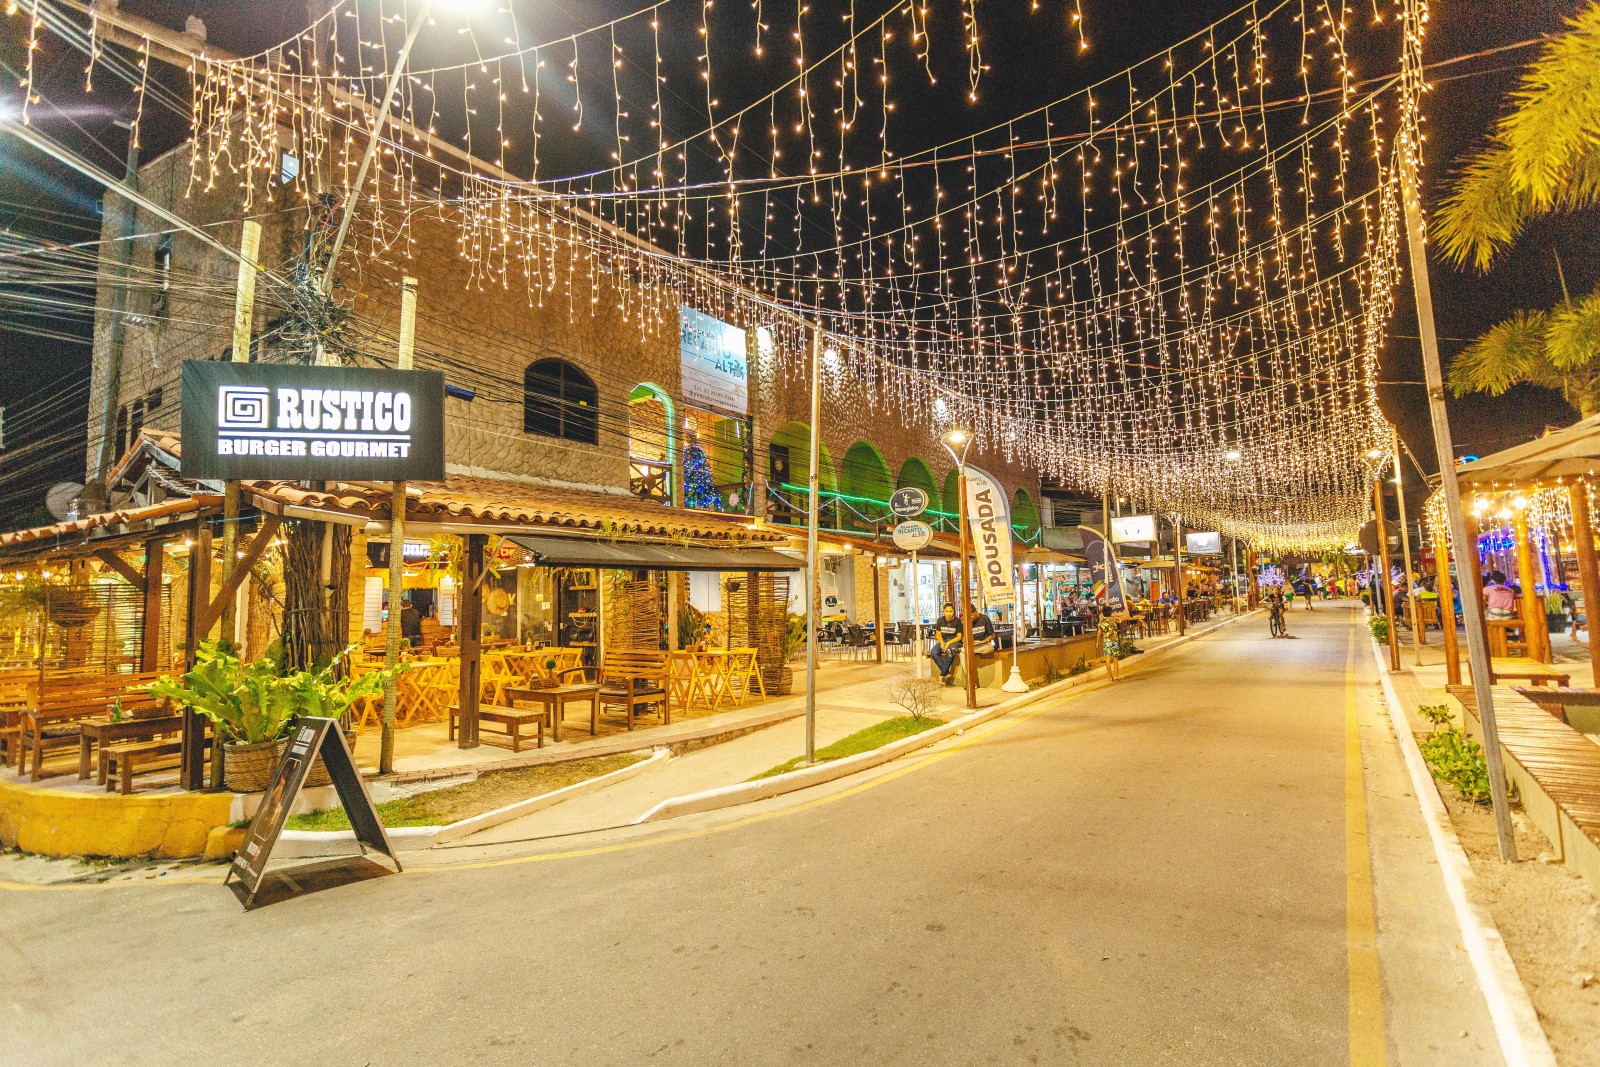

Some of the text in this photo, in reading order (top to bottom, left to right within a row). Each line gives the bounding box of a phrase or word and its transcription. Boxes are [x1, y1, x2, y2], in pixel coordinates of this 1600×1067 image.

[277, 388, 411, 432] RUSTICO
[218, 439, 411, 458] BURGER GOURMET
[976, 488, 1006, 587] POUSADA
